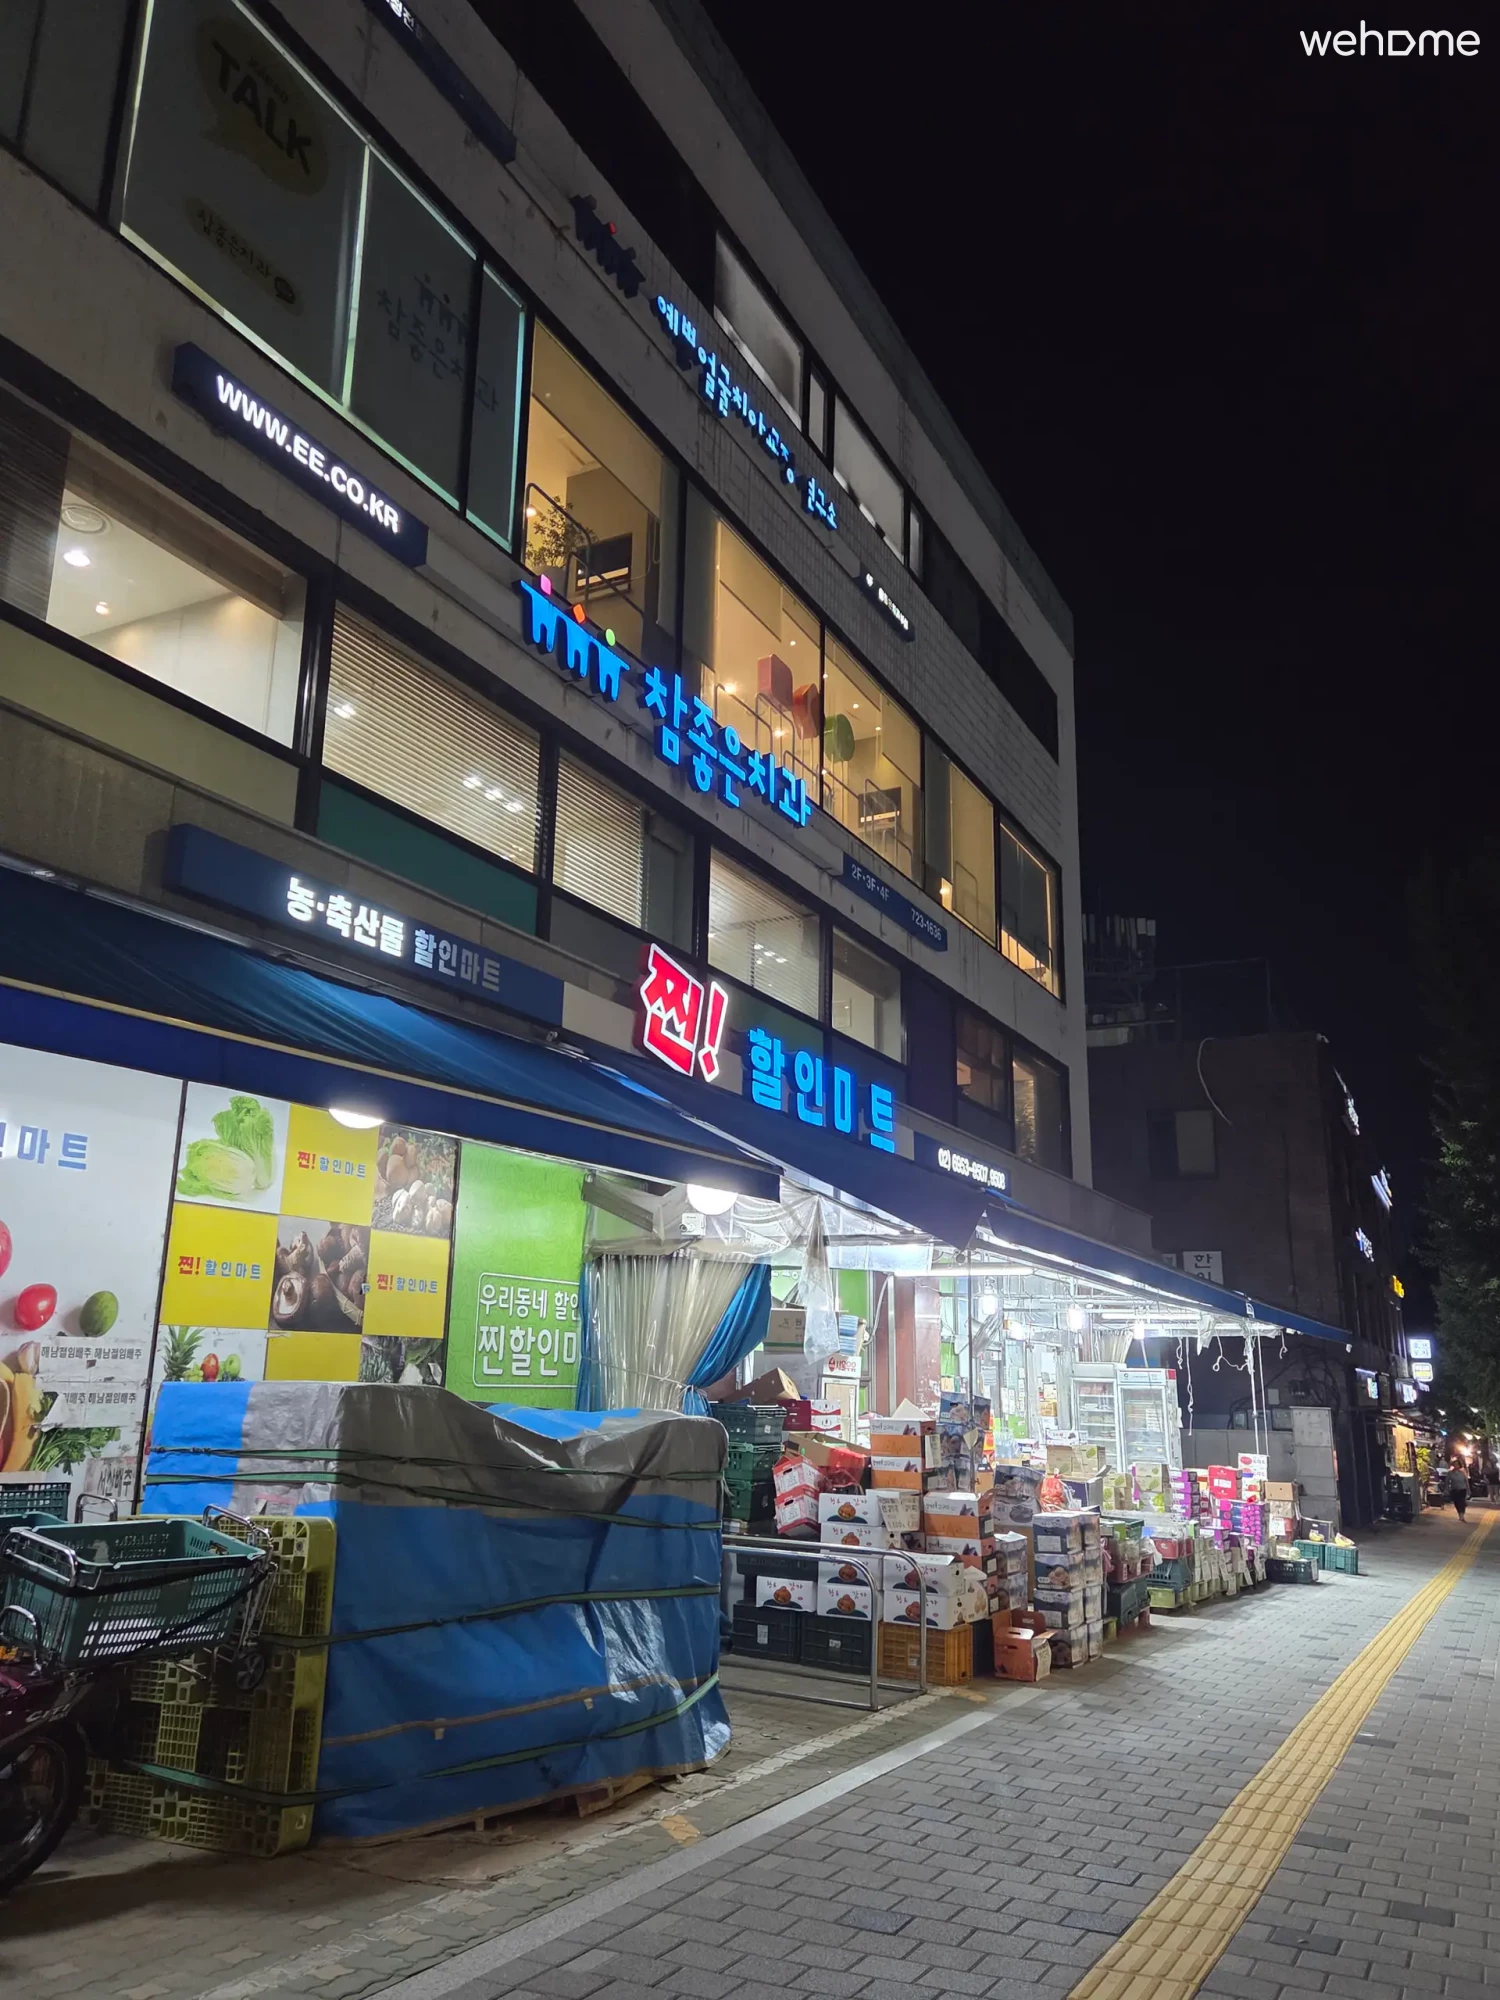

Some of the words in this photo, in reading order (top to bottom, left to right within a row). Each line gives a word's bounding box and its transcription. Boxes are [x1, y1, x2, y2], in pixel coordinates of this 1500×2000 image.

[211, 40, 312, 176] TALK
[215, 373, 400, 536] WWW.EE.CO.KR
[645, 665, 812, 827] 참좋은치과
[413, 928, 501, 993] 할인마트
[319, 1156, 366, 1179] 할인마트
[205, 1259, 261, 1280] 할인마트
[396, 1276, 438, 1294] 할인마트
[480, 1284, 547, 1319] 우리동네
